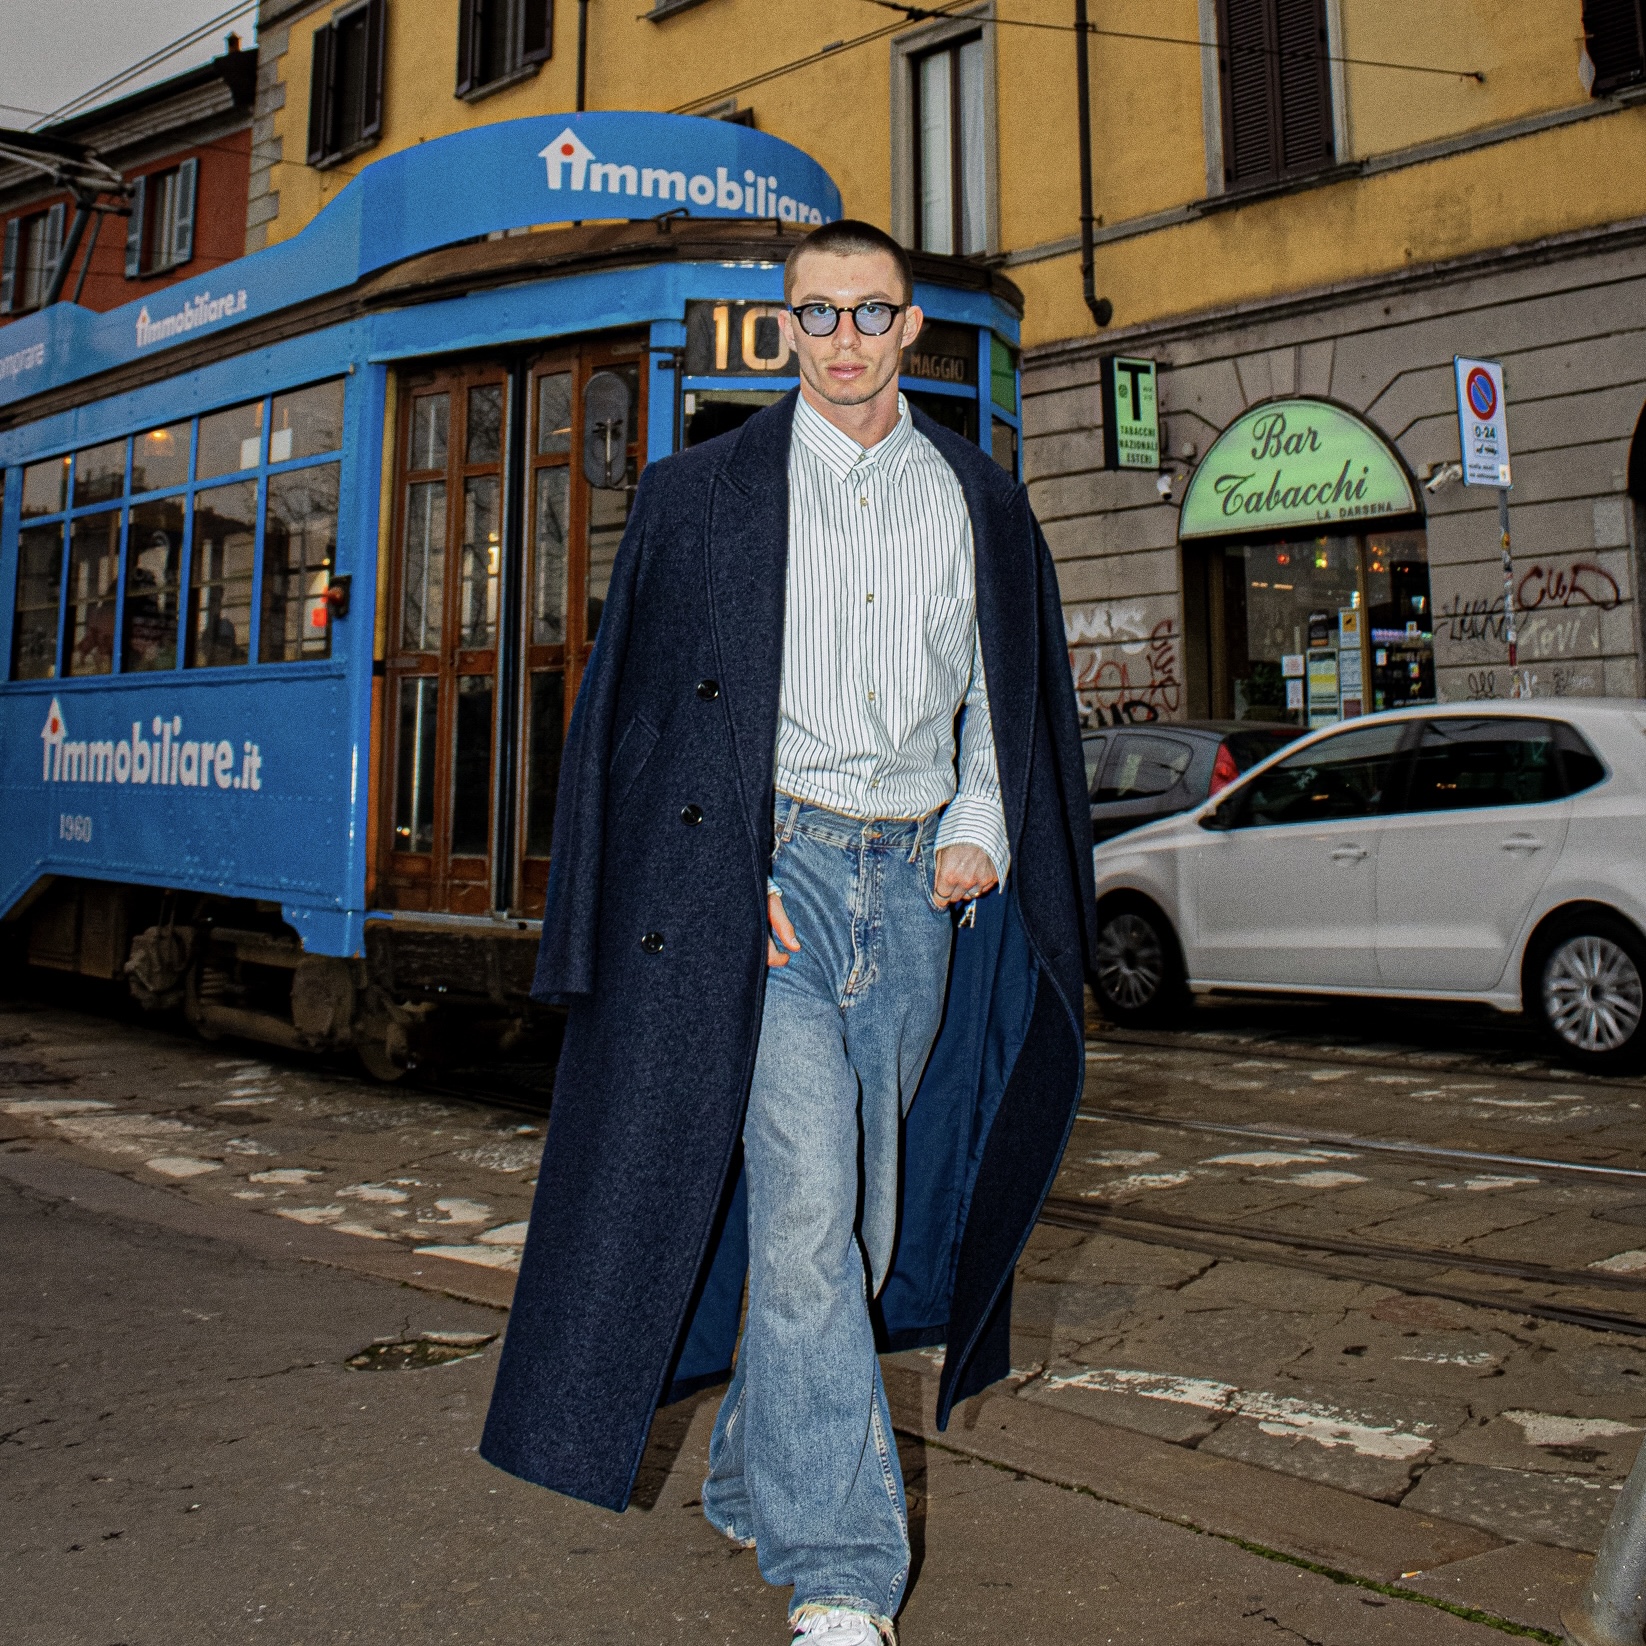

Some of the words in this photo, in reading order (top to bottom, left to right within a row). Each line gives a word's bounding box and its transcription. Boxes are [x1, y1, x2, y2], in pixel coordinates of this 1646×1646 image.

[713, 306, 790, 370] 10
[910, 353, 965, 381] MAGGIO
[1118, 363, 1151, 421] T
[1120, 426, 1156, 436] TABACCHI
[1251, 412, 1322, 460] Bar
[1474, 425, 1497, 439] 0-24
[1214, 460, 1368, 516] Tabacchi
[1317, 510, 1331, 520] LA
[1339, 503, 1394, 518] DARSENA
[60, 814, 93, 843] 1960
